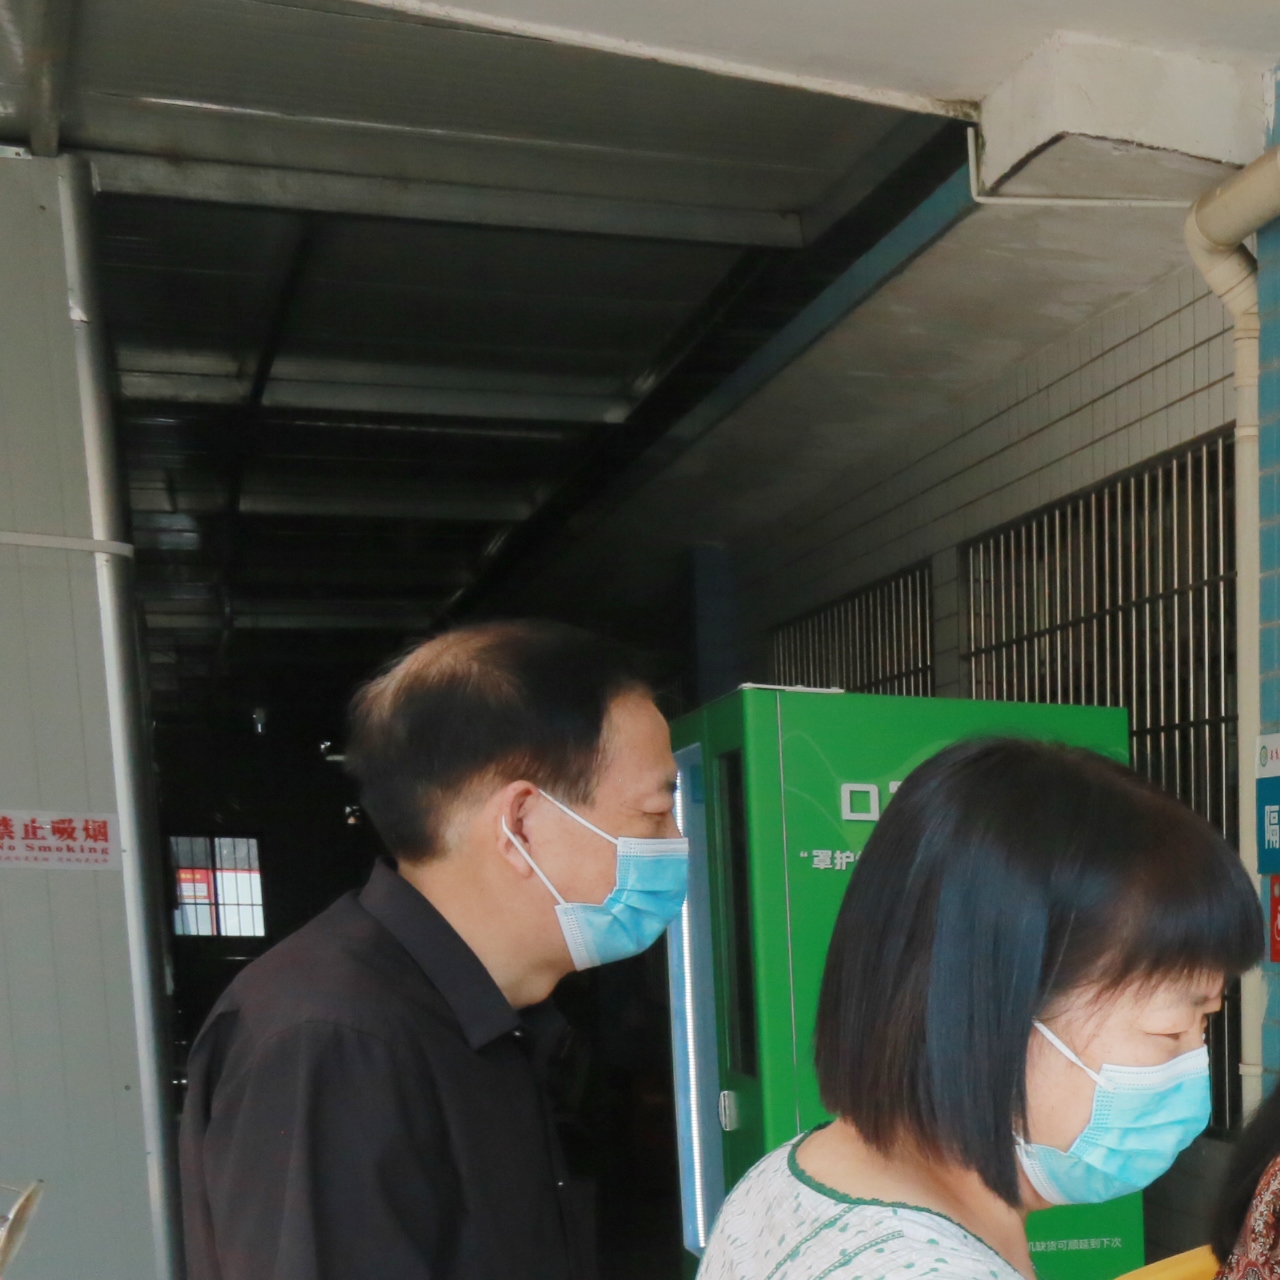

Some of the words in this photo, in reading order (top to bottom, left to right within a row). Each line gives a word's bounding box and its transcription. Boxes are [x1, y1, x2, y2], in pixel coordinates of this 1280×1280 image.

[0, 816, 109, 842] 禁止吸烟
[25, 843, 109, 855] Smoking
